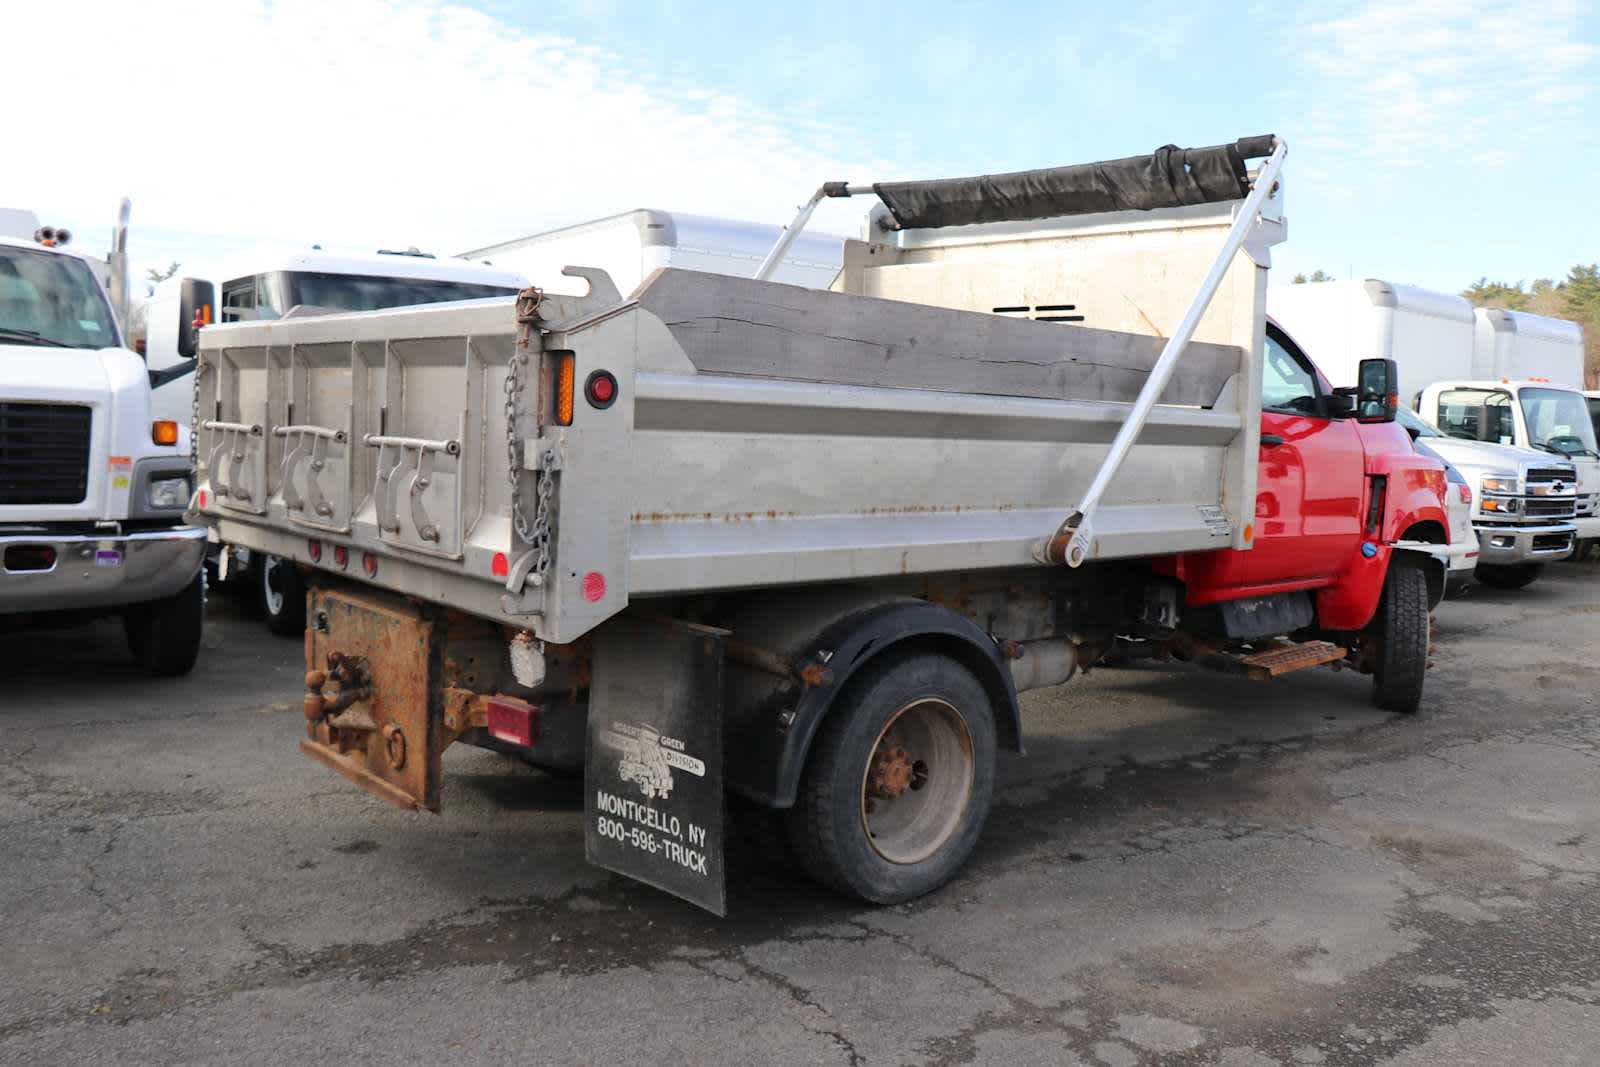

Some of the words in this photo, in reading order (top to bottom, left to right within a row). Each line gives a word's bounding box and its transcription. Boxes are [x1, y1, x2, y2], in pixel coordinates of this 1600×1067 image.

[660, 735, 685, 752] GREEN
[666, 752, 699, 770] DIVISION
[597, 791, 683, 842] MONTICELLO,
[688, 823, 706, 848] NY
